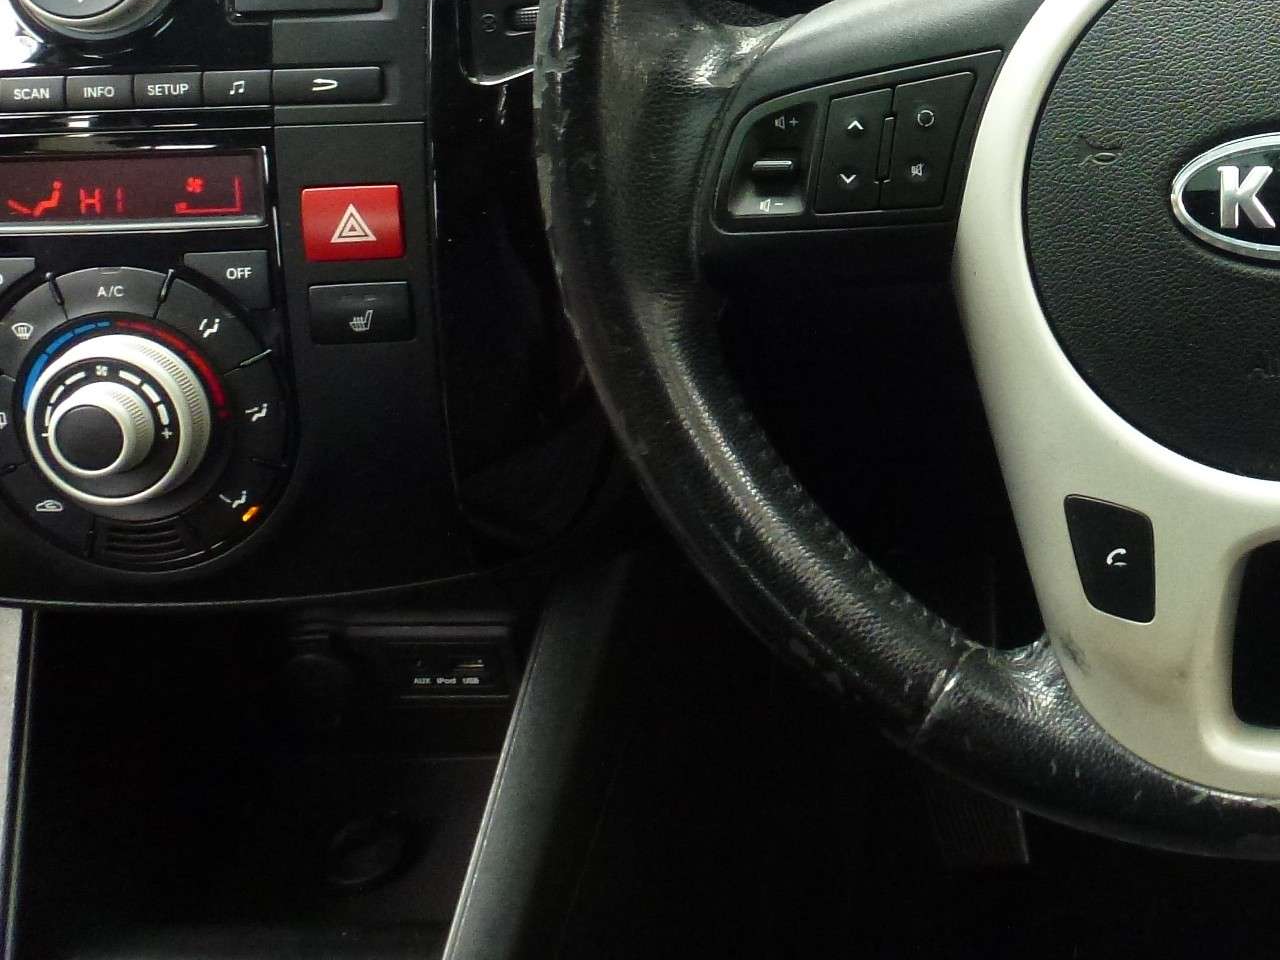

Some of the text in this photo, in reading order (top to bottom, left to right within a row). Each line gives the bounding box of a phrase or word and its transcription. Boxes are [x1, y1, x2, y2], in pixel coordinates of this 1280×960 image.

[13, 87, 50, 101] SCAN
[83, 86, 115, 99] INFO
[147, 83, 189, 98] SETUP
[226, 266, 252, 280] OFF
[97, 285, 124, 298] A/C
